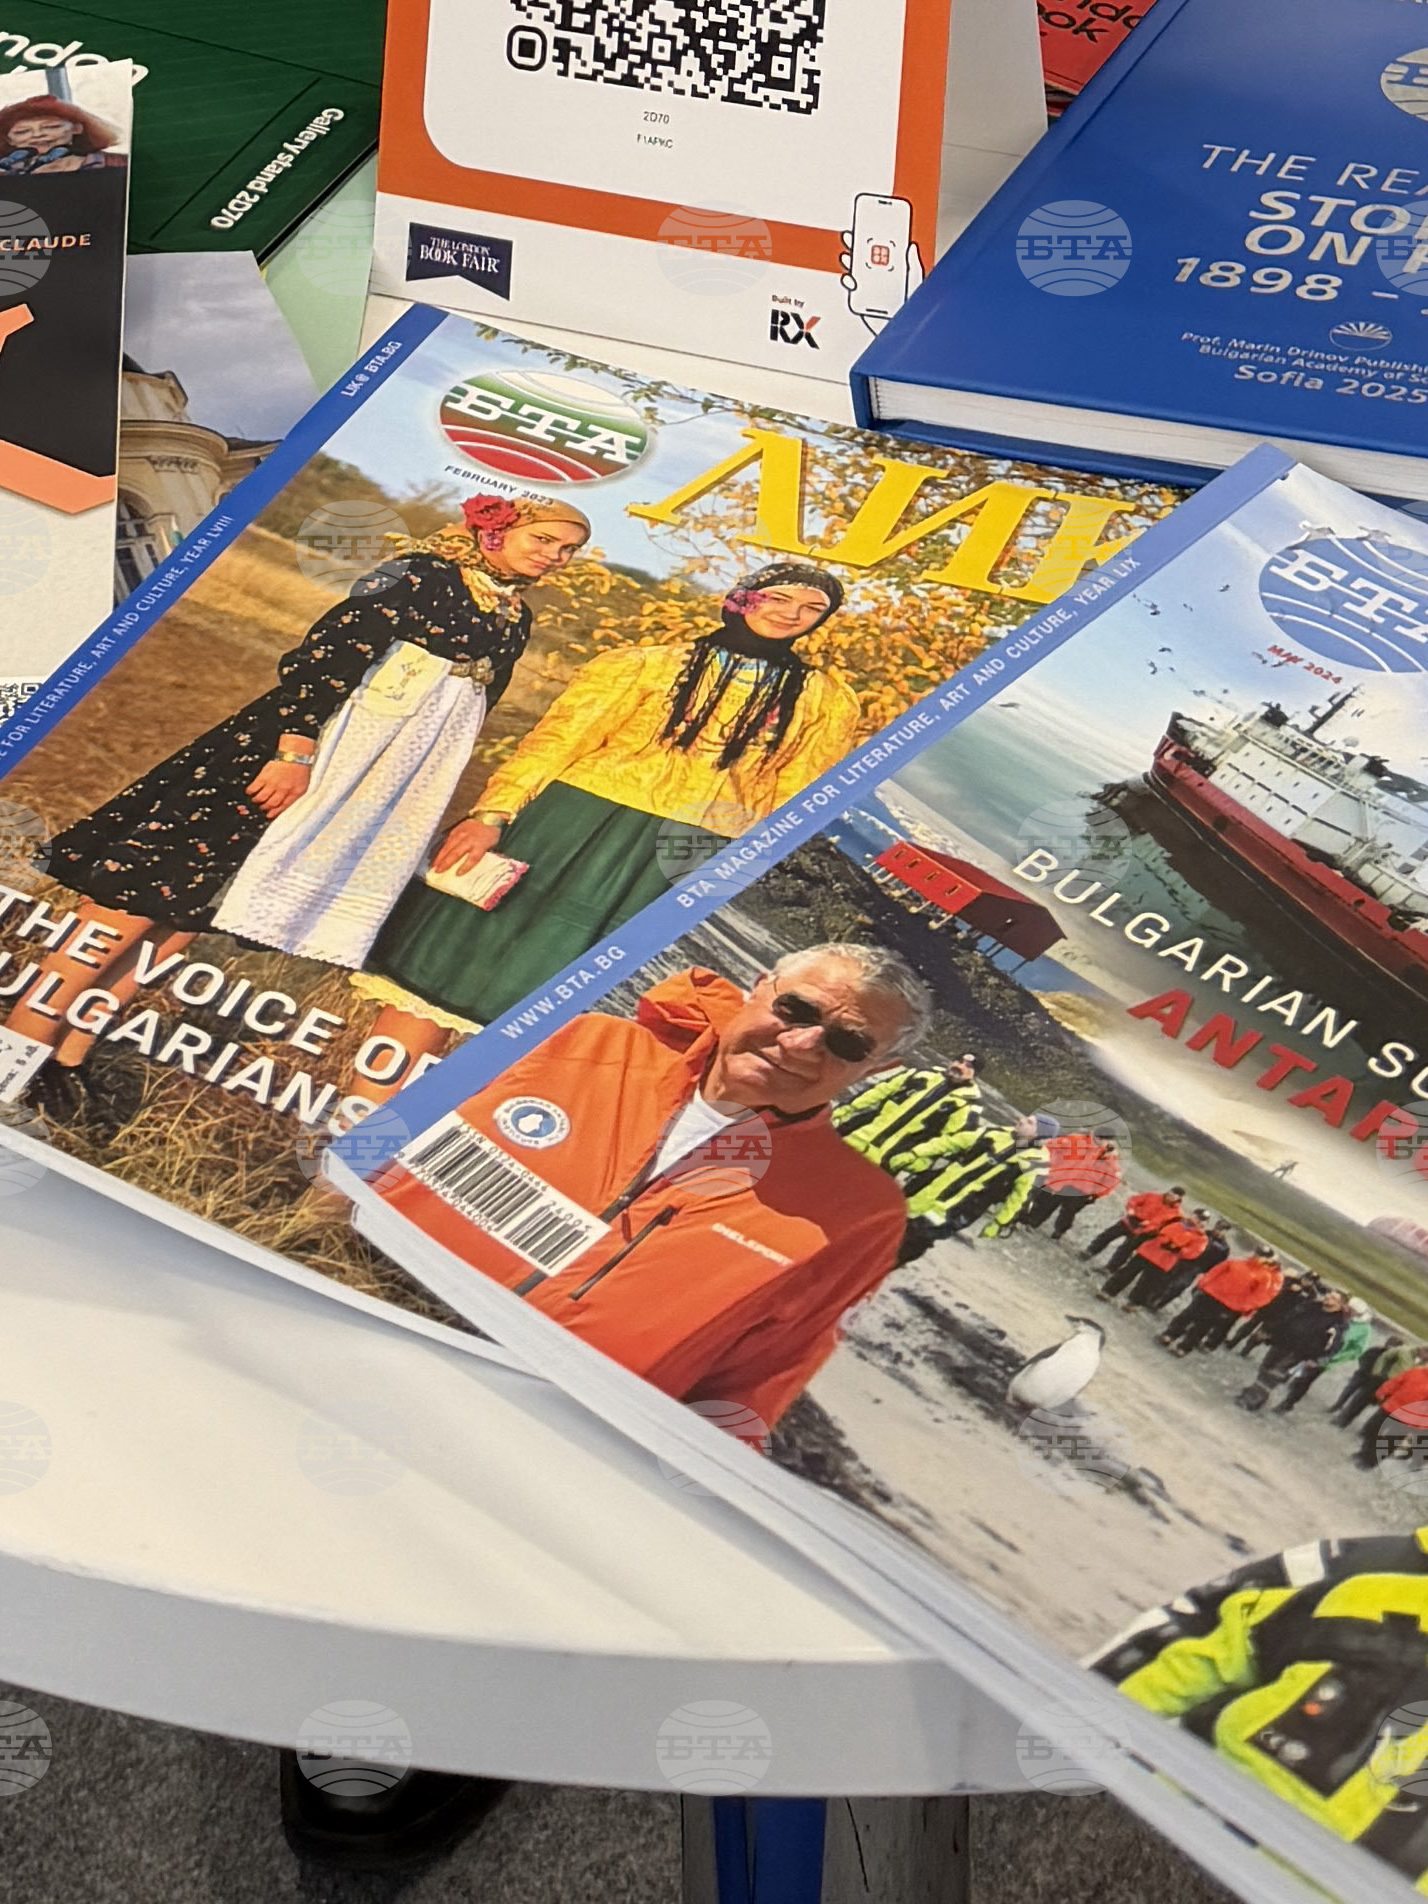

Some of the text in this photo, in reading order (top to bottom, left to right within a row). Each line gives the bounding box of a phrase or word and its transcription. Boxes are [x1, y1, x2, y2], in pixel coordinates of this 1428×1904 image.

[289, 106, 345, 152] Gallery
[252, 148, 298, 195] stand
[1200, 142, 1318, 182] THE
[418, 247, 501, 274] BOOK FAIR
[1242, 222, 1373, 268] ON
[1172, 254, 1345, 304] 1898
[768, 307, 823, 350] RX
[1227, 336, 1282, 355] Marin
[1286, 345, 1350, 365] Drinov
[1197, 343, 1288, 366] Bulgarian
[1291, 356, 1379, 380] Academy
[1233, 363, 1326, 392] Sofia
[444, 463, 518, 495] FEBRUARY
[1, 723, 32, 748] FOR
[30, 660, 98, 725] LITERATURE,
[90, 635, 117, 660] ART
[112, 610, 141, 637] AND
[135, 565, 189, 613] CULTURE,
[179, 537, 210, 565] YEAR
[1303, 662, 1343, 686] 2024
[499, 556, 1142, 1040] WWW.BTA.BG BTA MAGAZINE FOR LITERATURE, ART AND CULTURE, YEAR LIX
[1013, 847, 1358, 1050] BULGARIAN
[132, 940, 345, 1058] VOICE
